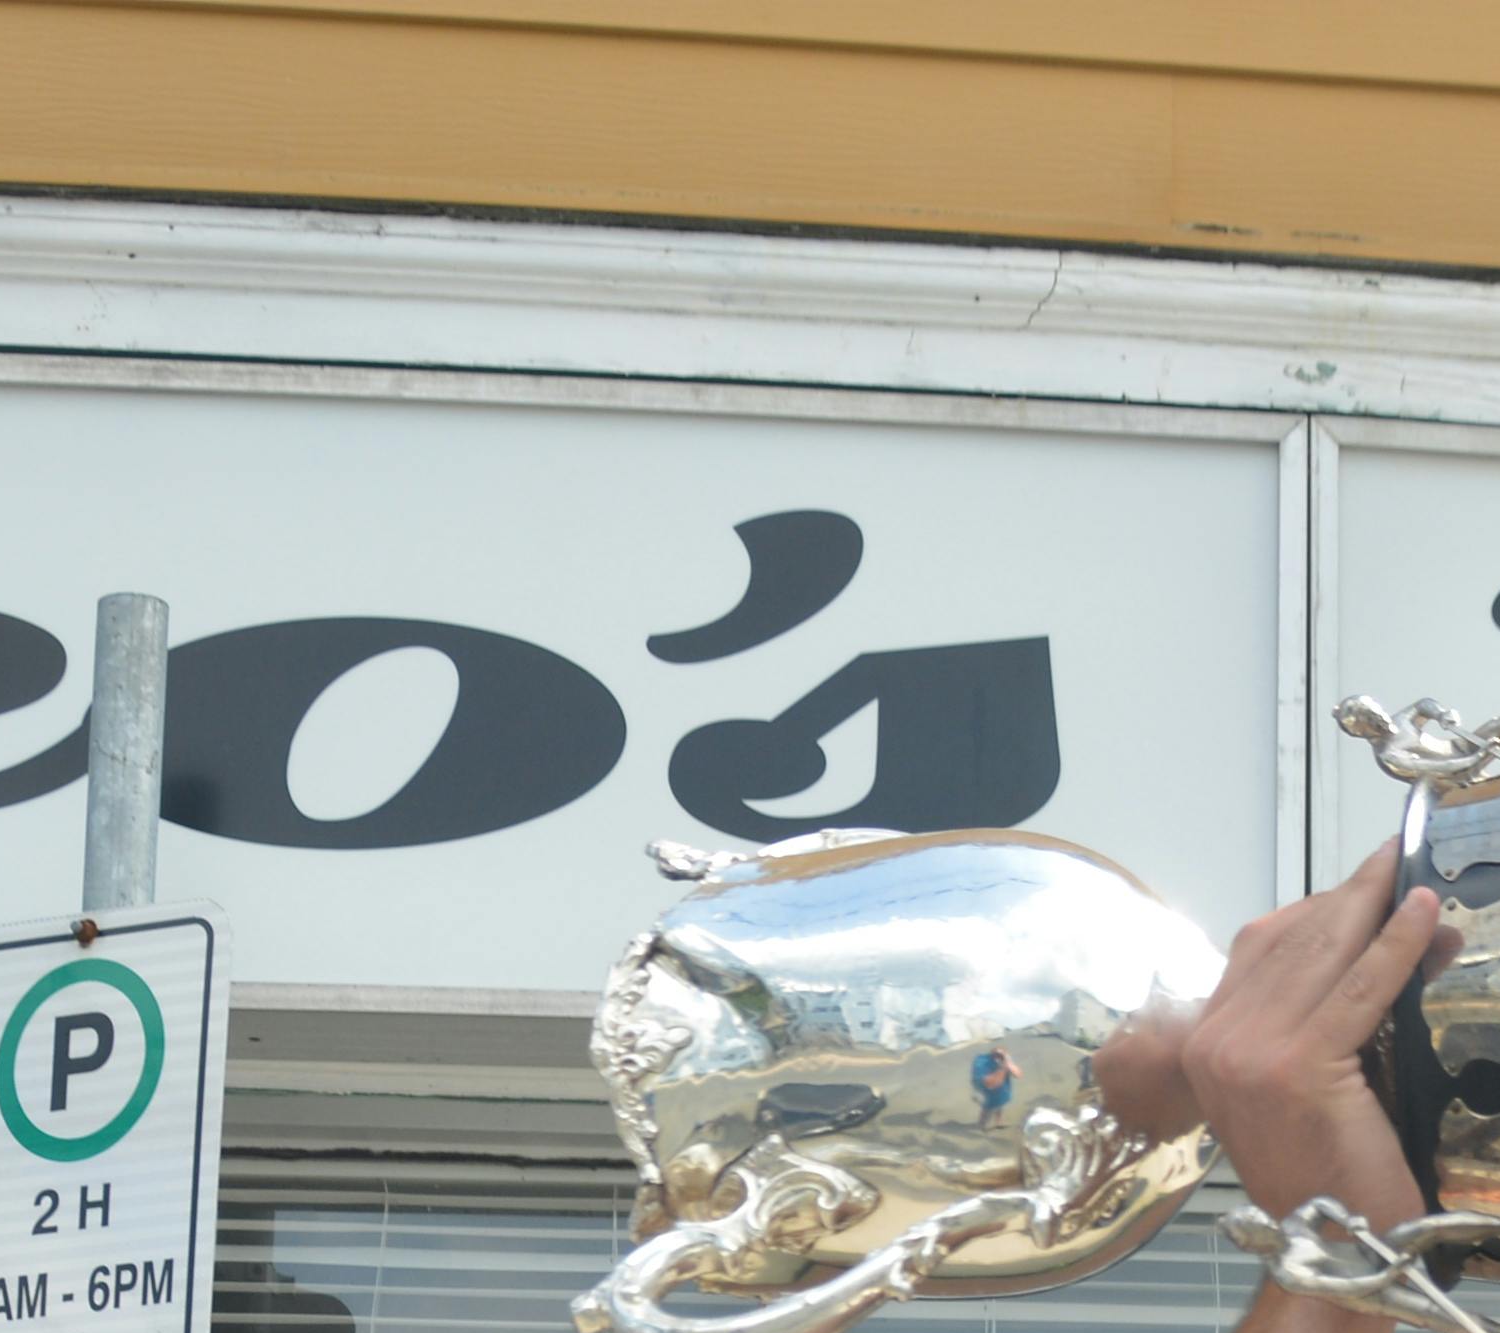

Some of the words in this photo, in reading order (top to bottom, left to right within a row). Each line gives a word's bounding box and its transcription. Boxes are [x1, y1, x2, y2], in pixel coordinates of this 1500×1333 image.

[49, 1011, 115, 1113] P
[31, 1188, 61, 1236] 2
[78, 1182, 112, 1231] H
[86, 1258, 175, 1313] 6PM
